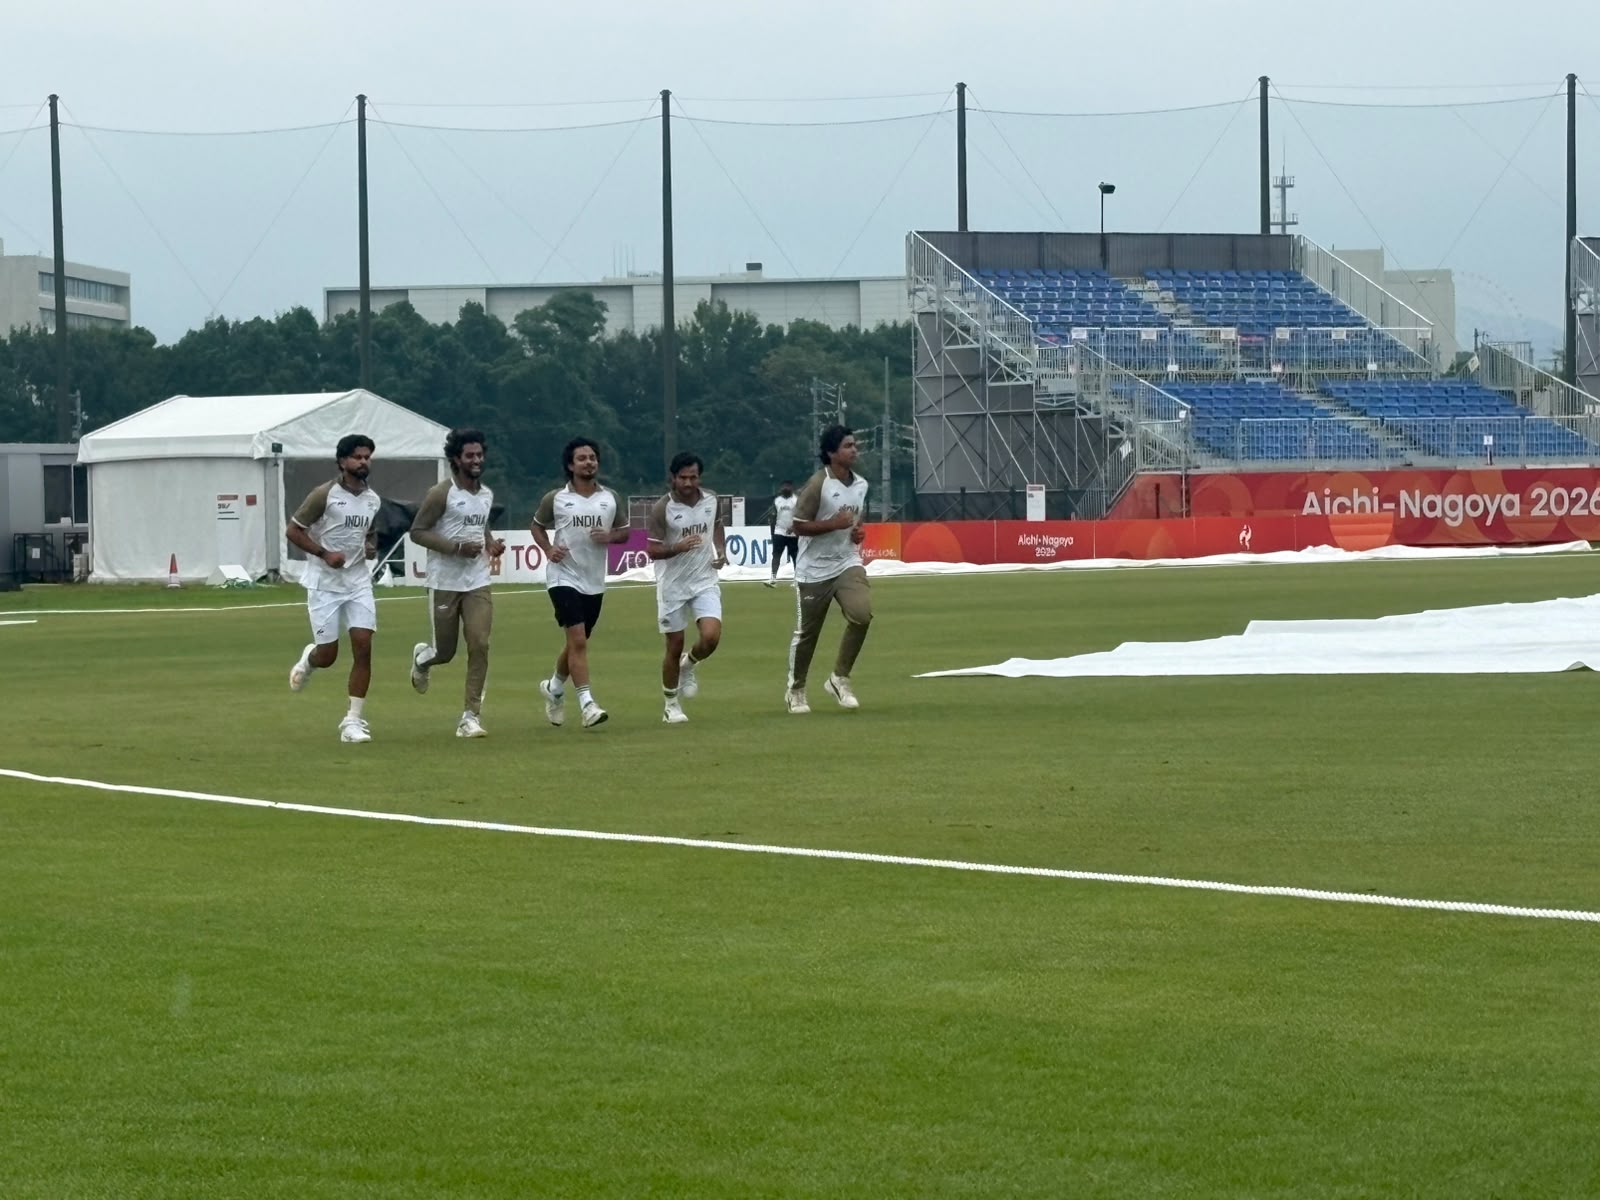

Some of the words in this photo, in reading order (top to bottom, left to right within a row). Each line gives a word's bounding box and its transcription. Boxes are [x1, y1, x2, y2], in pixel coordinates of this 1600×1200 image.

[1302, 487, 1520, 526] Aichi-Nagoya
[345, 515, 369, 528] INDIA
[573, 515, 602, 527] INDIA
[682, 522, 708, 537] INDIA
